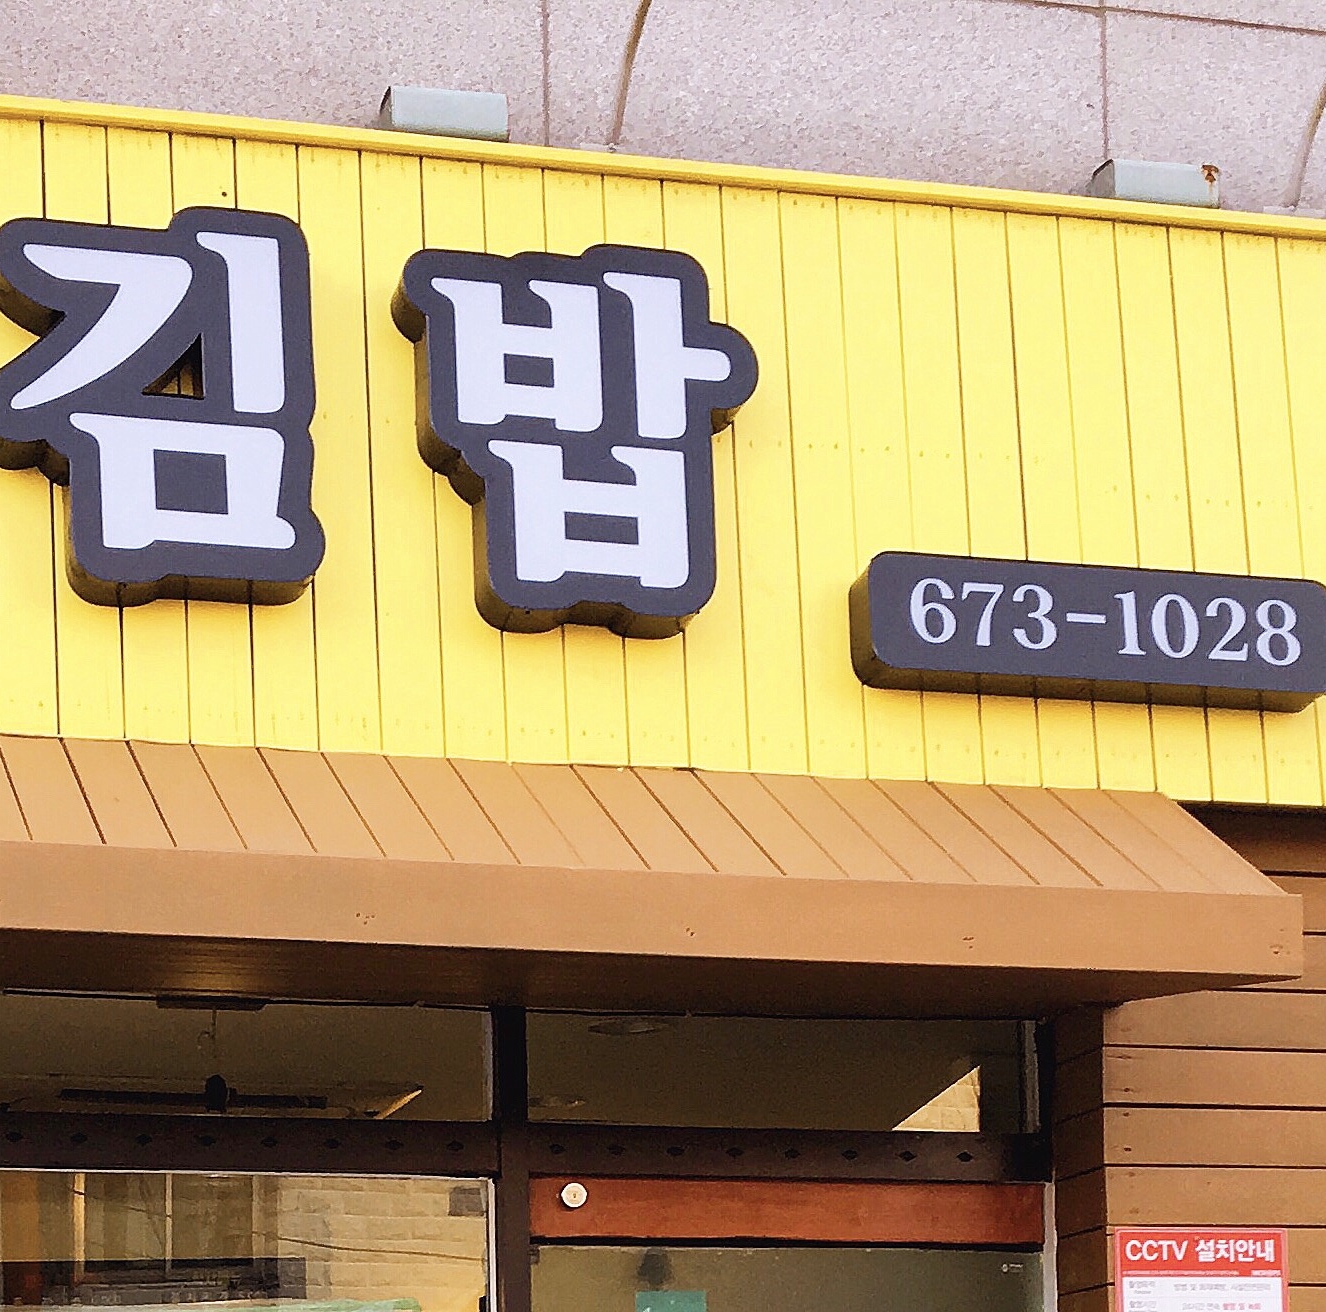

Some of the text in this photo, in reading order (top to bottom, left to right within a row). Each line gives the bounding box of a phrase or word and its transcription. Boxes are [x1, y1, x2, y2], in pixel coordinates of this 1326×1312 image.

[908, 577, 1302, 667] 673-1028
[1124, 1238, 1276, 1263] CCTV 설치안내
